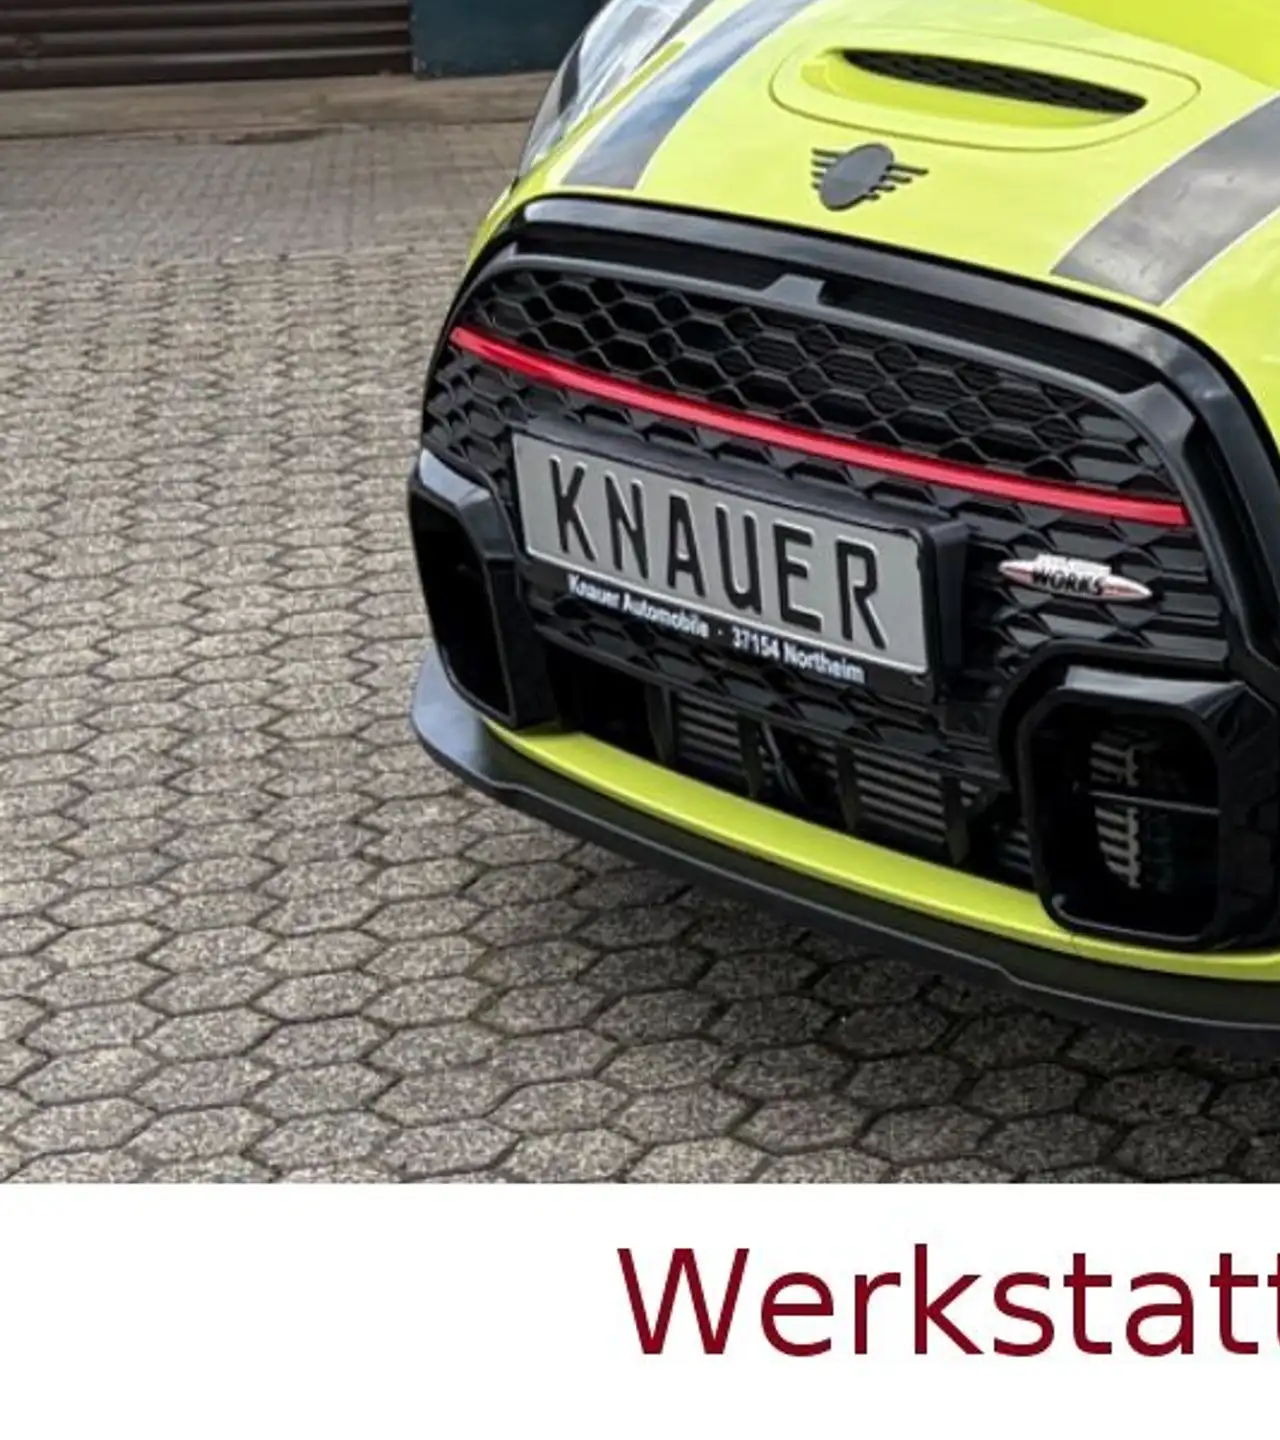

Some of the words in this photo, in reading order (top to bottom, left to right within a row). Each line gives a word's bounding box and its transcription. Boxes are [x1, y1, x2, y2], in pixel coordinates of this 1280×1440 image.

[550, 455, 888, 650] KNAUER
[567, 573, 621, 610] Knauer
[622, 591, 709, 638] Automobile
[731, 625, 780, 660] 37154
[782, 642, 866, 684] Northeim
